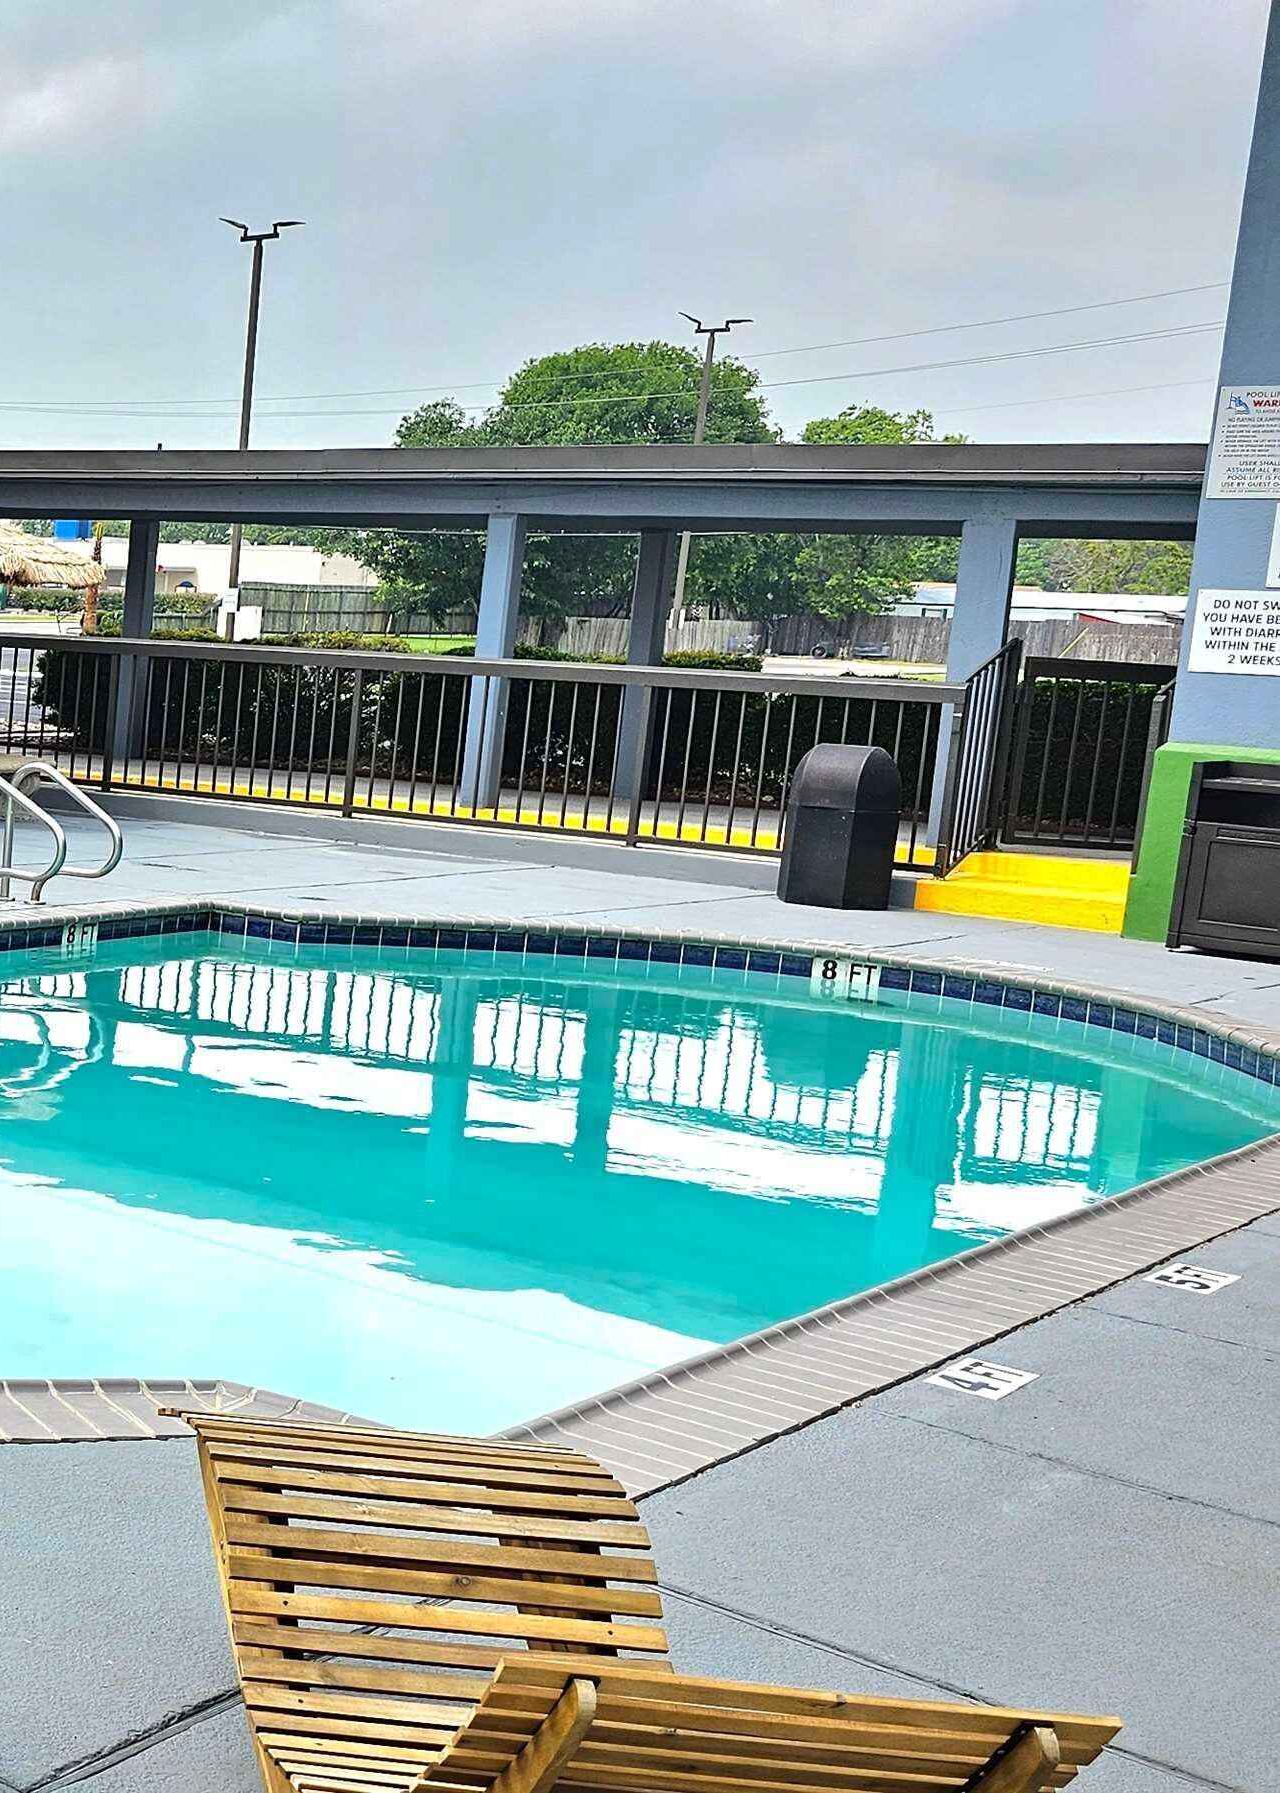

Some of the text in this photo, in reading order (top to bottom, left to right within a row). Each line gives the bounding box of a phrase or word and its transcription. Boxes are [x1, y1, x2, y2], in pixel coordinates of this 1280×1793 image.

[1253, 399, 1280, 407] WAR
[1213, 599, 1230, 609] DO
[1234, 600, 1259, 610] NOT
[1203, 613, 1227, 623] YOU
[1231, 613, 1263, 624] HAVE
[1210, 626, 1242, 637] WITH
[1204, 640, 1277, 652] WITHIN THE
[1227, 654, 1235, 664] 2
[67, 923, 97, 945] 8 FT
[822, 959, 877, 985] 8 FT
[1154, 1265, 1228, 1290] 5 FT
[939, 1362, 1023, 1391] 4 FT
